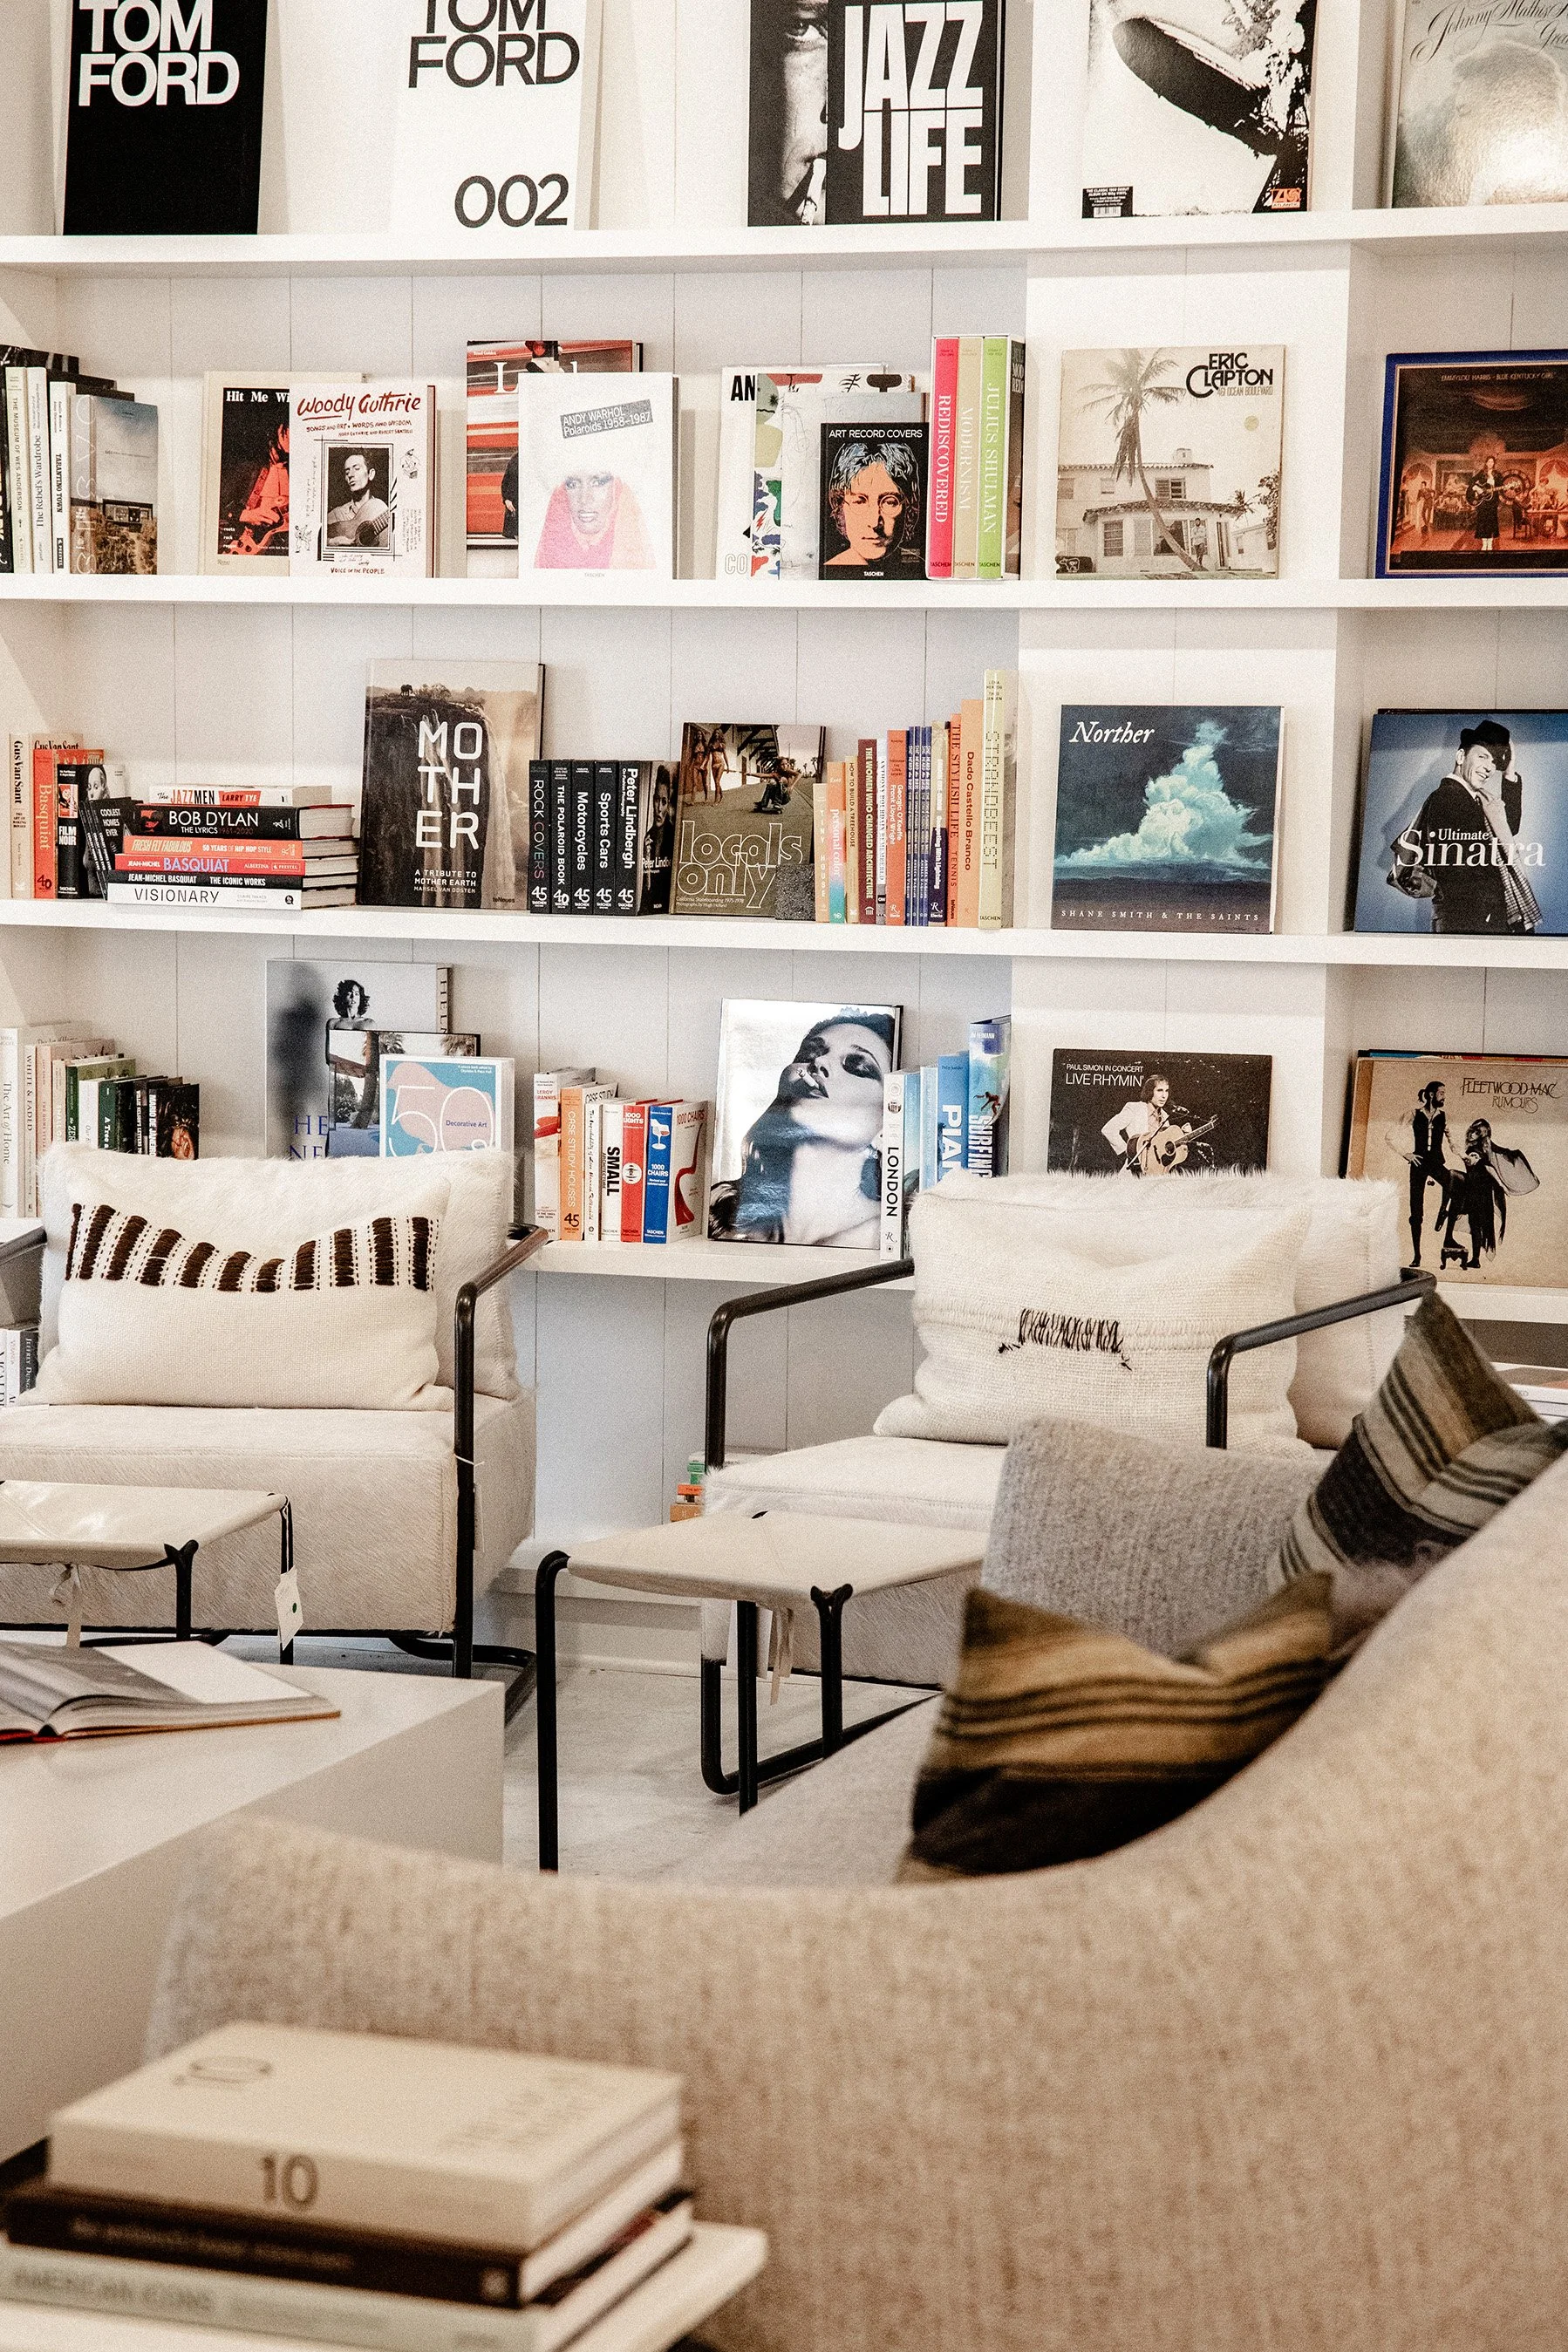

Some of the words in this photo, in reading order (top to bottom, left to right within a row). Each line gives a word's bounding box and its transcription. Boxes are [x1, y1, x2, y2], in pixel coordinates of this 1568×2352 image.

[78, 0, 211, 51] TOM
[426, 0, 546, 34] TOM
[1410, 2, 1492, 66] Johnny
[409, 31, 581, 89] FORD
[838, 0, 983, 150] JAZZ
[78, 51, 240, 106] FORD
[862, 108, 983, 216] LIFE
[454, 174, 569, 228] 002
[1209, 351, 1249, 370] ERIC
[225, 391, 243, 402] Hit
[250, 392, 268, 403] Me
[1186, 365, 1273, 399] CLAPTON
[297, 394, 355, 420] Woody
[358, 391, 420, 413] Guthrie
[562, 412, 587, 426] ANDY
[588, 406, 624, 422] WARHOL
[986, 383, 999, 444] JULIUS
[828, 429, 847, 439] ART
[849, 429, 884, 439] RECORD
[886, 429, 923, 439] COVERS
[33, 435, 42, 480] Wardrobe
[935, 394, 951, 523] REDISCOVERED
[958, 406, 974, 510] MODERNISM
[34, 481, 43, 510] Rebel's
[983, 448, 998, 534] SHULMAN
[418, 720, 483, 760] MO
[1069, 721, 1155, 745] Norther
[13, 740, 24, 760] Gus
[14, 761, 24, 780] Van
[966, 751, 975, 781] Dado
[14, 781, 24, 804] Sant
[417, 765, 480, 806] TH
[534, 780, 544, 818] ROCK
[627, 768, 638, 802] Peter
[36, 784, 52, 850] Basquiat
[168, 810, 201, 826] BOB
[206, 811, 259, 827] DYLAN
[598, 792, 611, 836] Sports
[965, 782, 974, 828] Castello
[58, 826, 77, 836] FILM
[58, 835, 77, 846] NOIR
[106, 828, 119, 837] EVER
[415, 810, 480, 850] ER
[575, 791, 589, 871] Motorcycles
[622, 806, 637, 869] Lindbergh
[831, 808, 842, 850] personal
[1437, 828, 1489, 842] Ultimate
[131, 839, 152, 851] FRESH
[153, 839, 161, 852] FLY
[161, 840, 193, 853] FABULOUS
[534, 821, 545, 879] COVERS
[600, 839, 611, 869] Cars
[679, 821, 803, 868] locals
[965, 829, 973, 870] Branco
[1396, 829, 1546, 868] Sinatra
[128, 873, 167, 883] JEAN-MICHEL
[168, 875, 197, 884] BASQUIAT
[164, 857, 229, 872] BASQUIAT
[557, 857, 566, 885] BOOK
[833, 852, 842, 876] color
[209, 876, 221, 884] THE
[222, 876, 242, 885] ICONIC
[244, 877, 266, 886] WORKS
[531, 886, 548, 901] 45
[678, 852, 776, 908] only
[134, 888, 220, 903] VISIONARY
[574, 888, 590, 903] 45
[596, 888, 612, 903] 45
[617, 888, 634, 903] 45
[1061, 910, 1104, 918] SHANE
[1111, 910, 1154, 919] SMITH
[1176, 912, 1203, 921] THE
[1210, 913, 1260, 922] SAINTS
[1065, 1073, 1091, 1086] LIVE
[1093, 1074, 1144, 1087] RHYMIN'
[1083, 1063, 1103, 1072] SIMON
[1111, 1064, 1144, 1073] CONCERT
[3, 1081, 12, 1102] The
[1460, 1078, 1528, 1096] FLEETWOOD
[1531, 1081, 1564, 1099] MAC
[3, 1104, 12, 1121] Art
[1492, 1096, 1539, 1114] RUMOURS
[3, 1121, 12, 1131] of
[3, 1133, 12, 1164] Home
[607, 1146, 620, 1196] SMALL
[886, 1147, 899, 1217] LONDON
[563, 1212, 580, 1227] 45
[262, 2153, 319, 2210] 10
